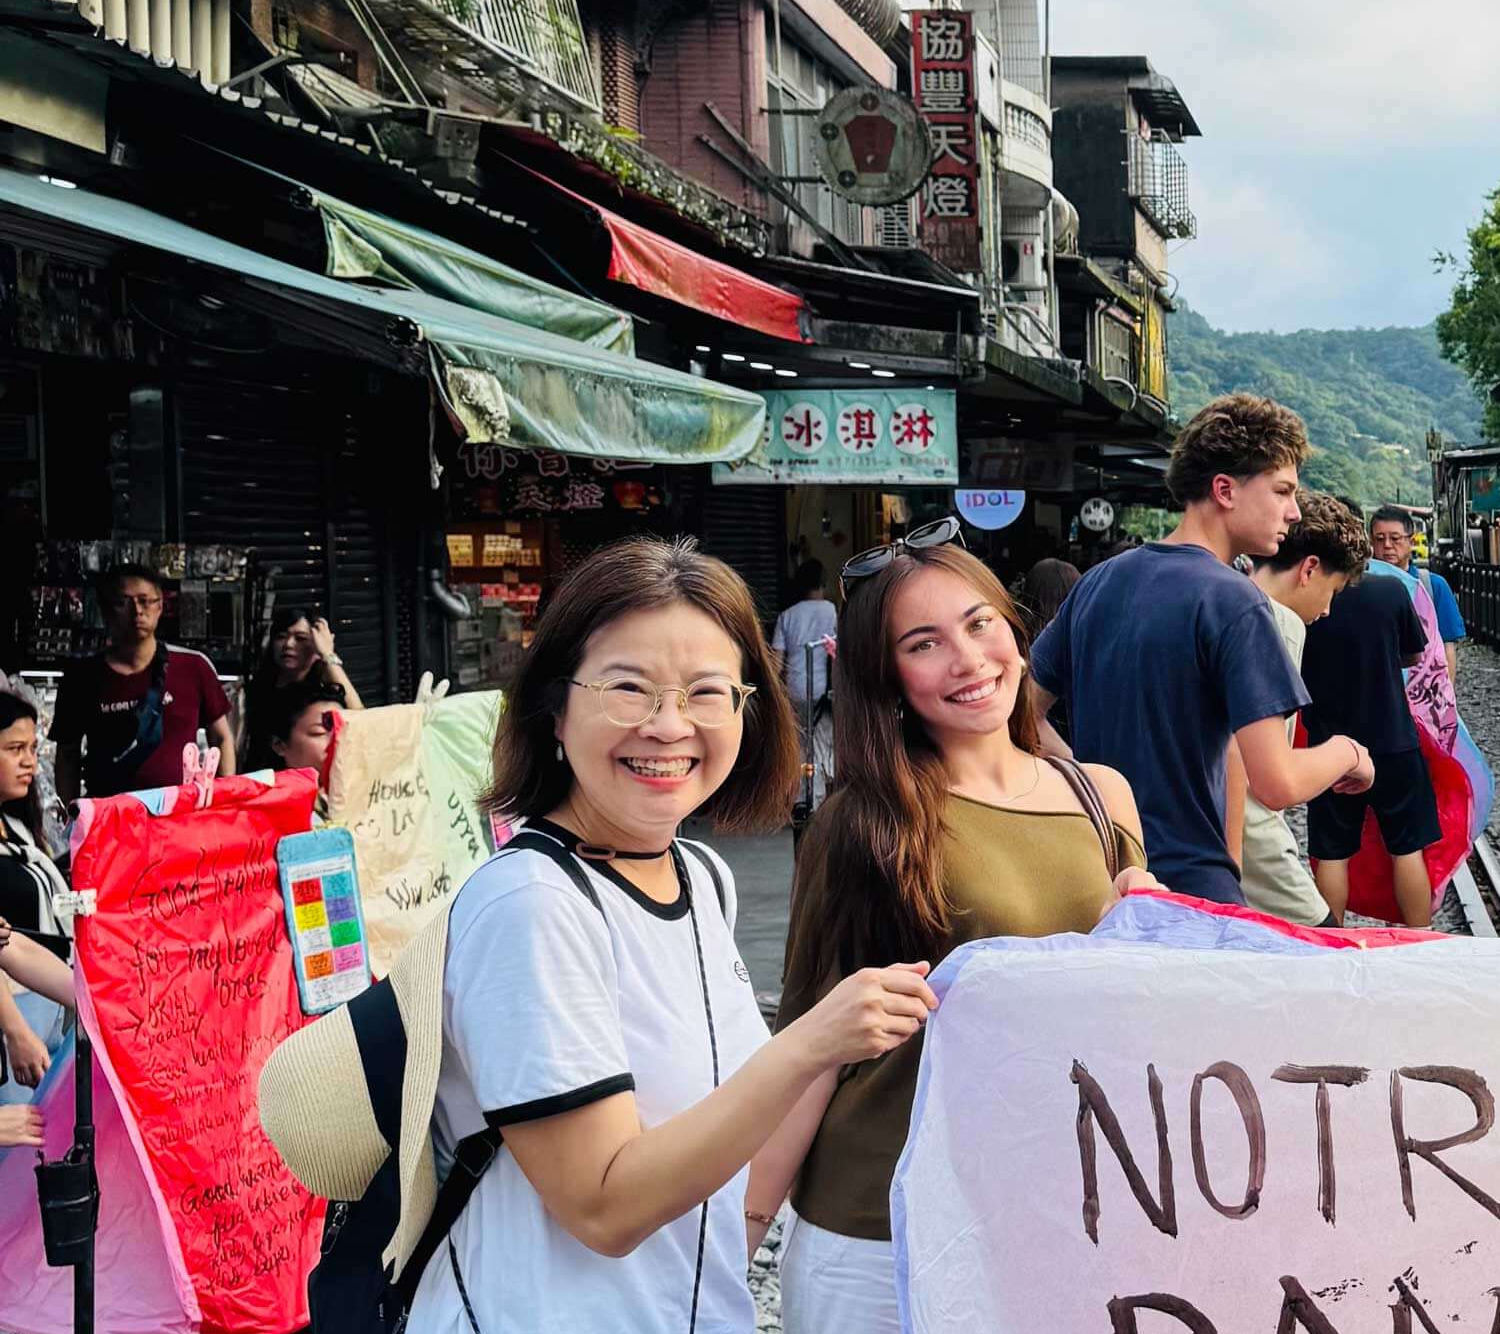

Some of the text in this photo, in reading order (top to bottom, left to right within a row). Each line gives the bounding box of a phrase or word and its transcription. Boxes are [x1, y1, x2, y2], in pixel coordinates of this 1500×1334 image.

[919, 18, 970, 218] 協豐天燈
[764, 409, 935, 449] 冰淇淋
